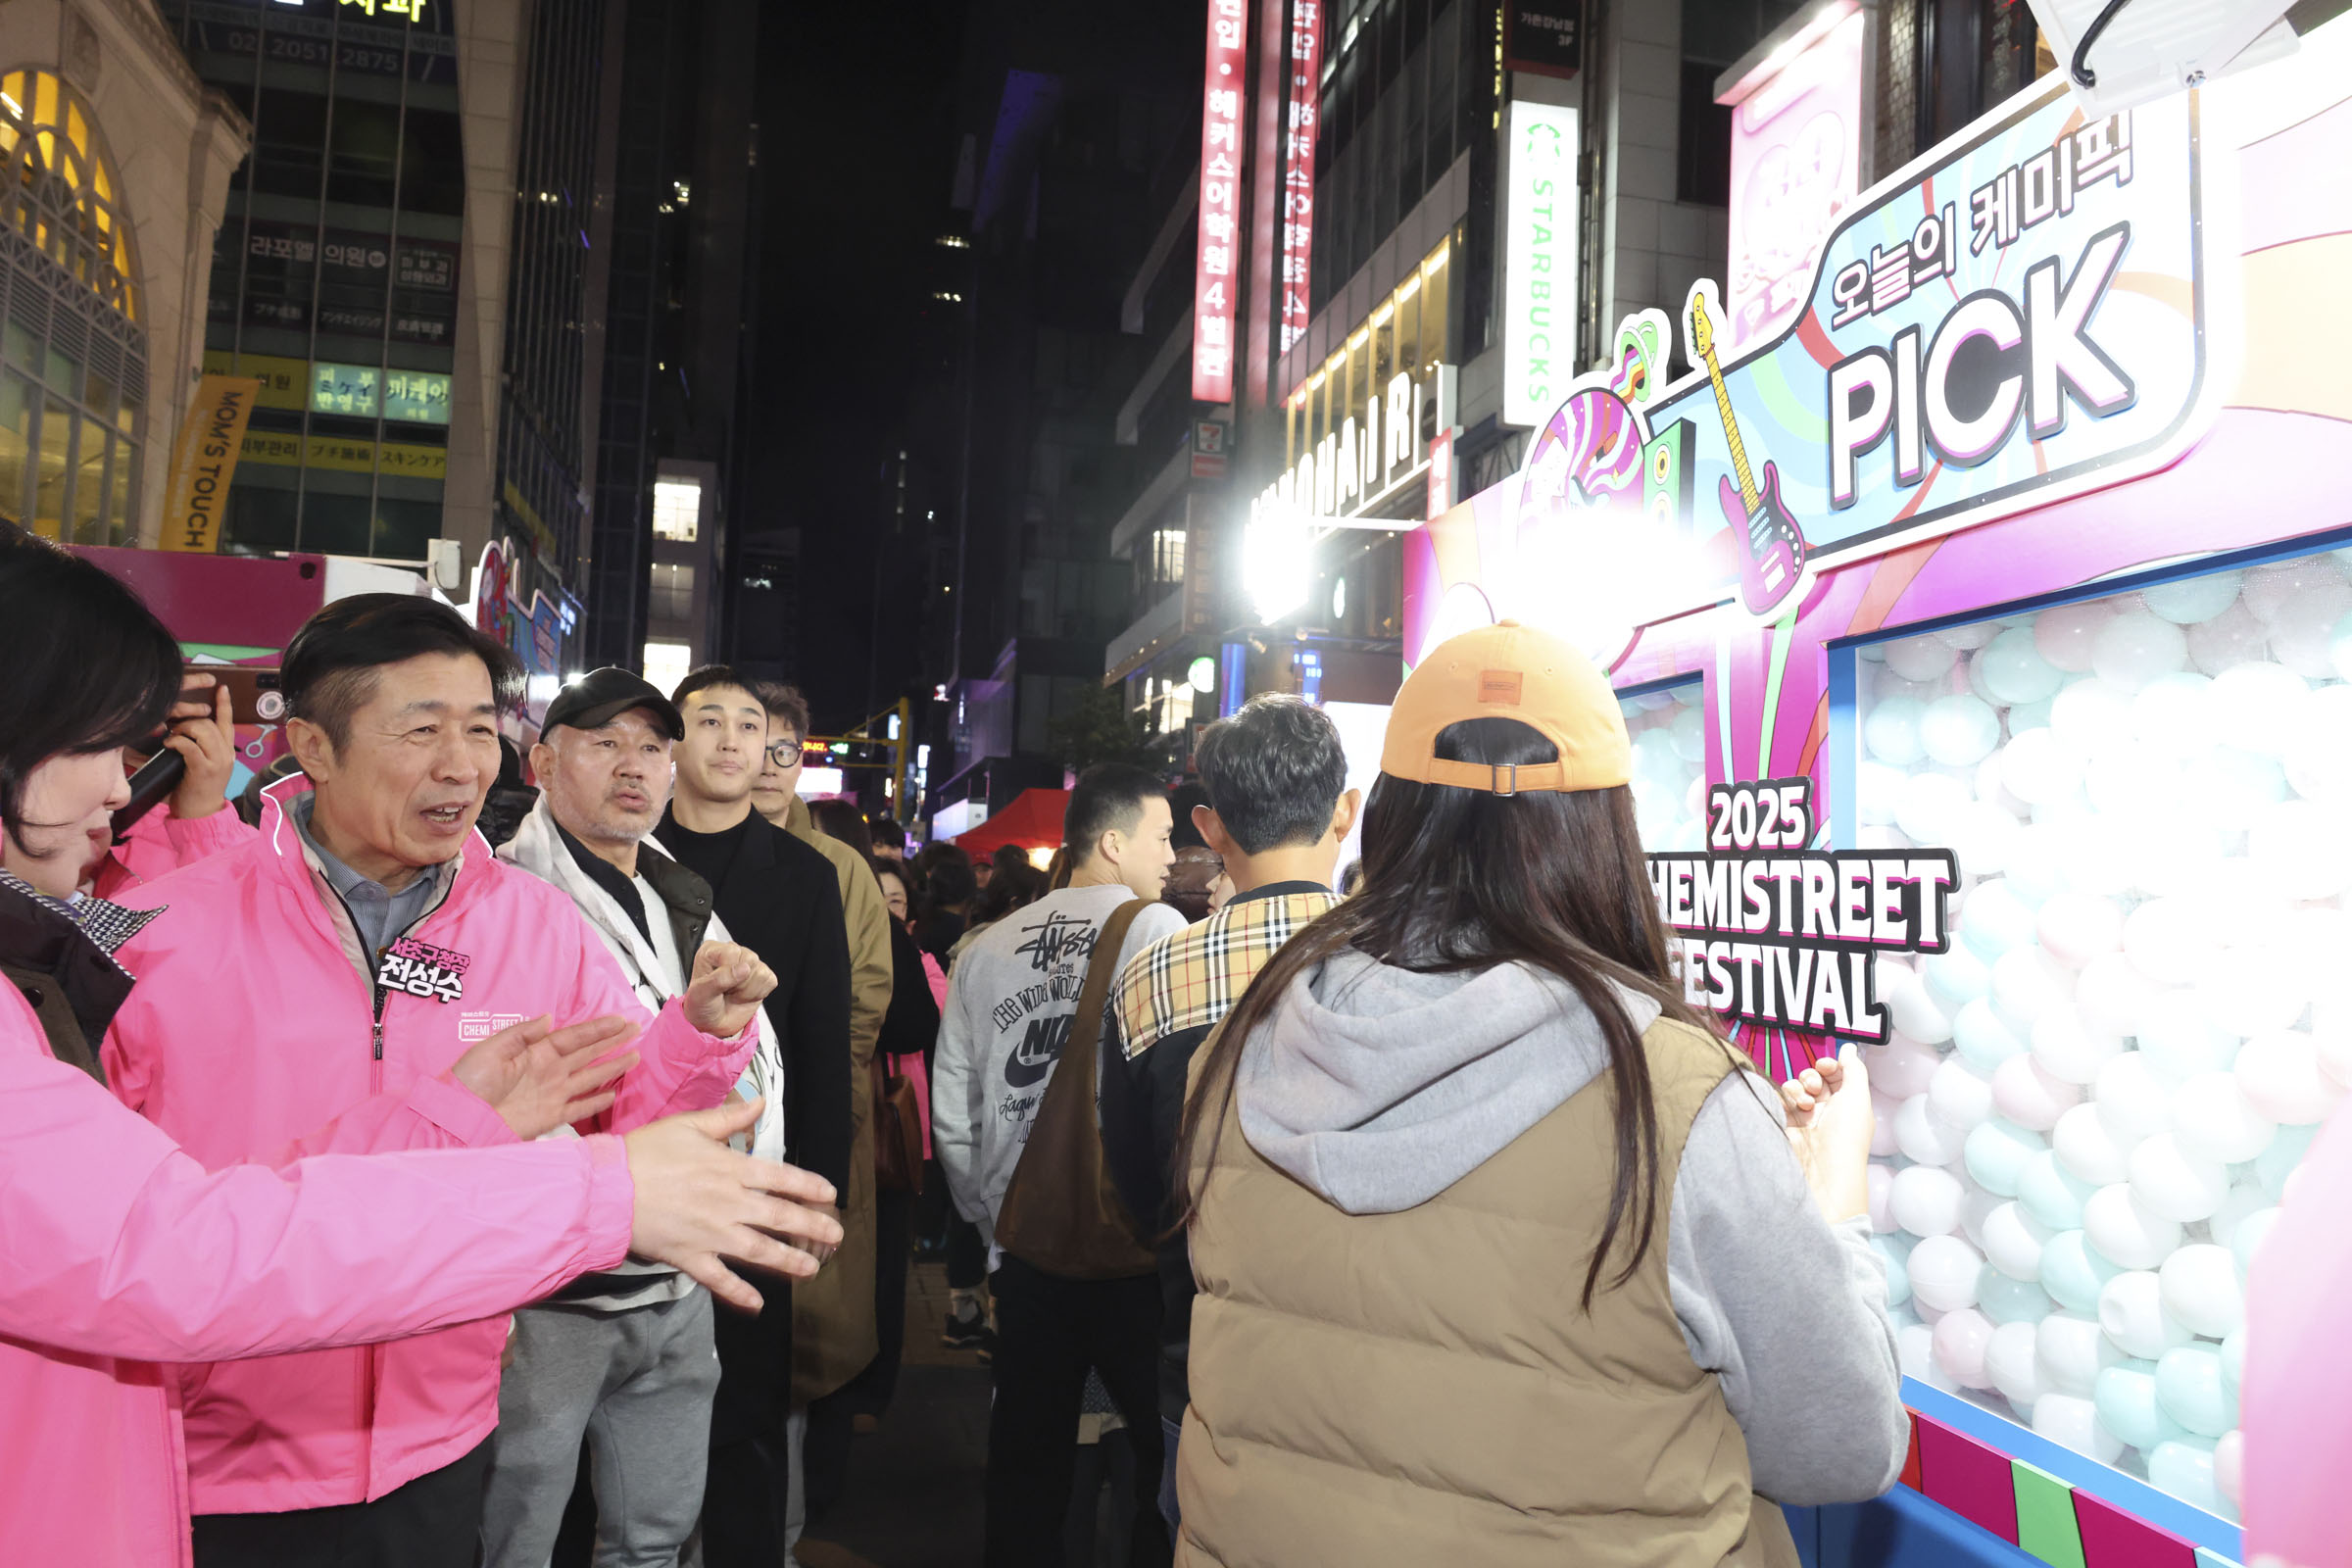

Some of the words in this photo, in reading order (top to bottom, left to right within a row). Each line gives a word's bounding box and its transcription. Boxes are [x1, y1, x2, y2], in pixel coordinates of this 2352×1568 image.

[1832, 202, 1955, 330] 오늘의
[1971, 112, 2132, 256] 케미픽
[323, 243, 367, 268] 의원
[1528, 178, 1553, 403] STARBUCKS
[1829, 220, 2137, 510] PICK
[204, 391, 243, 457] MOM'S
[183, 465, 221, 548] TOUCH
[1710, 786, 1810, 851] 2025
[1645, 858, 1950, 948] HEMISTREET
[377, 954, 462, 1003] 전성수
[388, 937, 470, 975] 서초구청장
[464, 1024, 490, 1036] CHEMI
